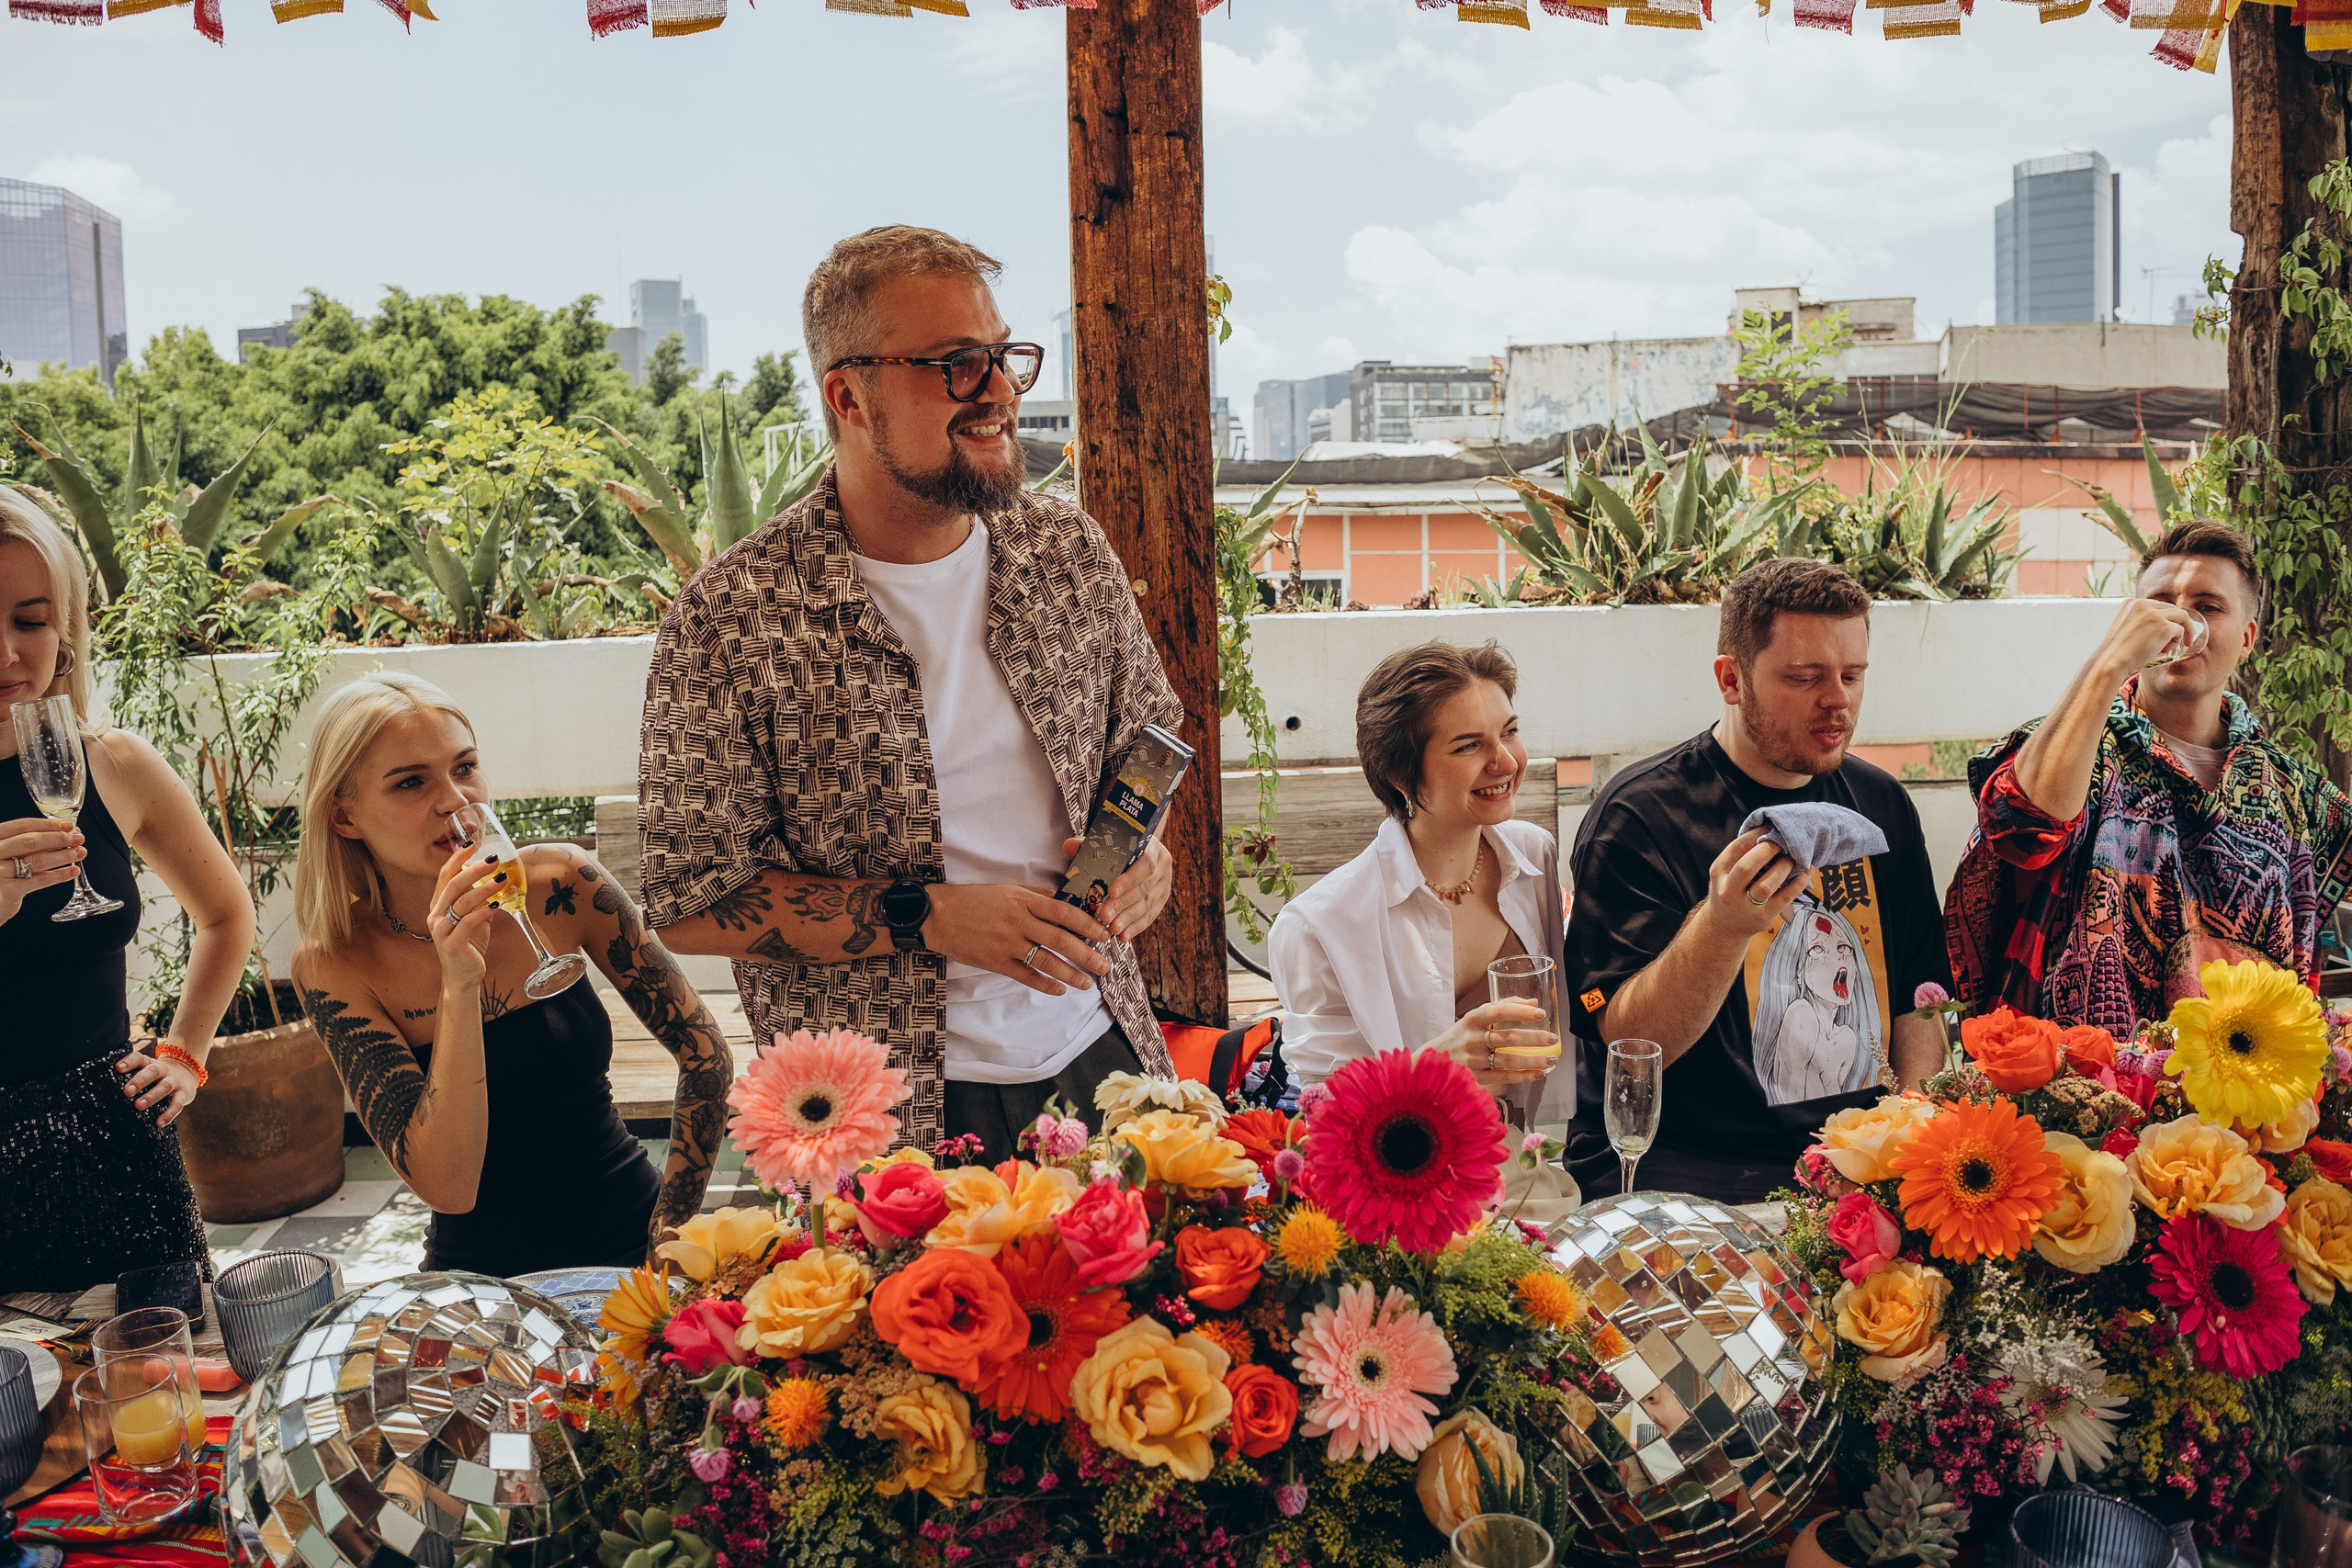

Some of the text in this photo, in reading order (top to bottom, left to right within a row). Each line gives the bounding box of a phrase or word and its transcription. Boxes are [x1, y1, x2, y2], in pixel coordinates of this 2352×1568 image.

[1118, 799, 1138, 818] PLATA
[1122, 791, 1144, 811] LLAMA
[414, 1009, 425, 1018] Me
